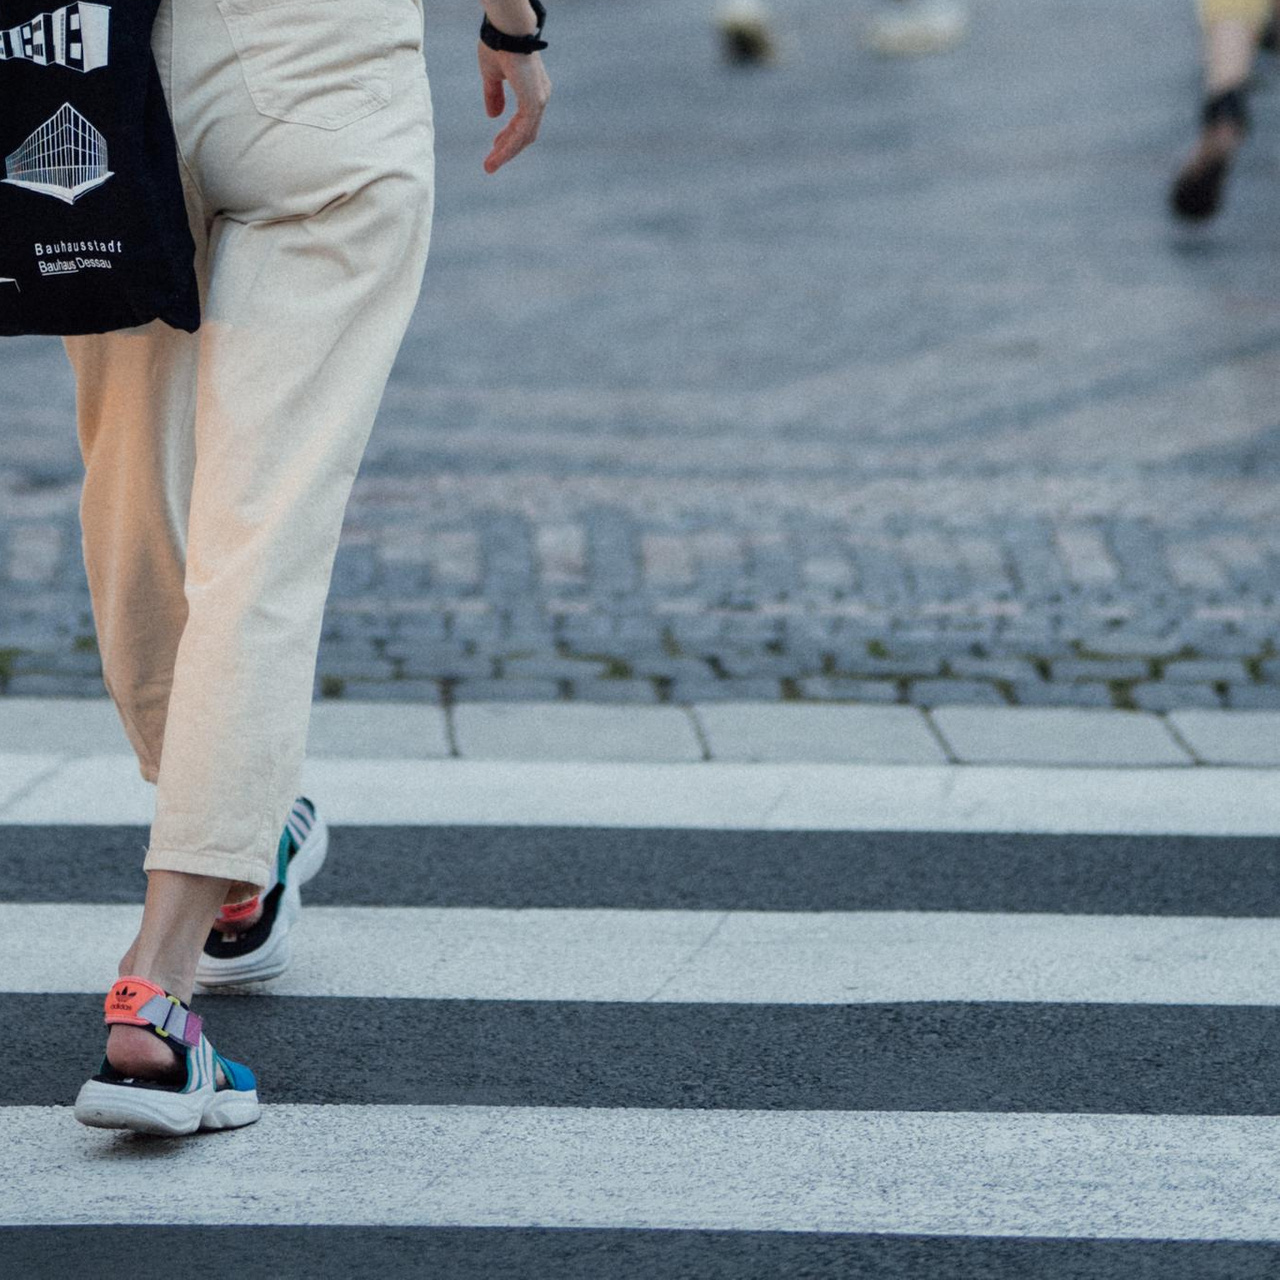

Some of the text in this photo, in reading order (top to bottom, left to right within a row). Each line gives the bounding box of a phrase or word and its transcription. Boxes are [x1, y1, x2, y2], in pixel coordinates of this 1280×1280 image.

[34, 239, 122, 256] Bauhausstadt
[38, 256, 112, 273] Bauhaus Dessau
